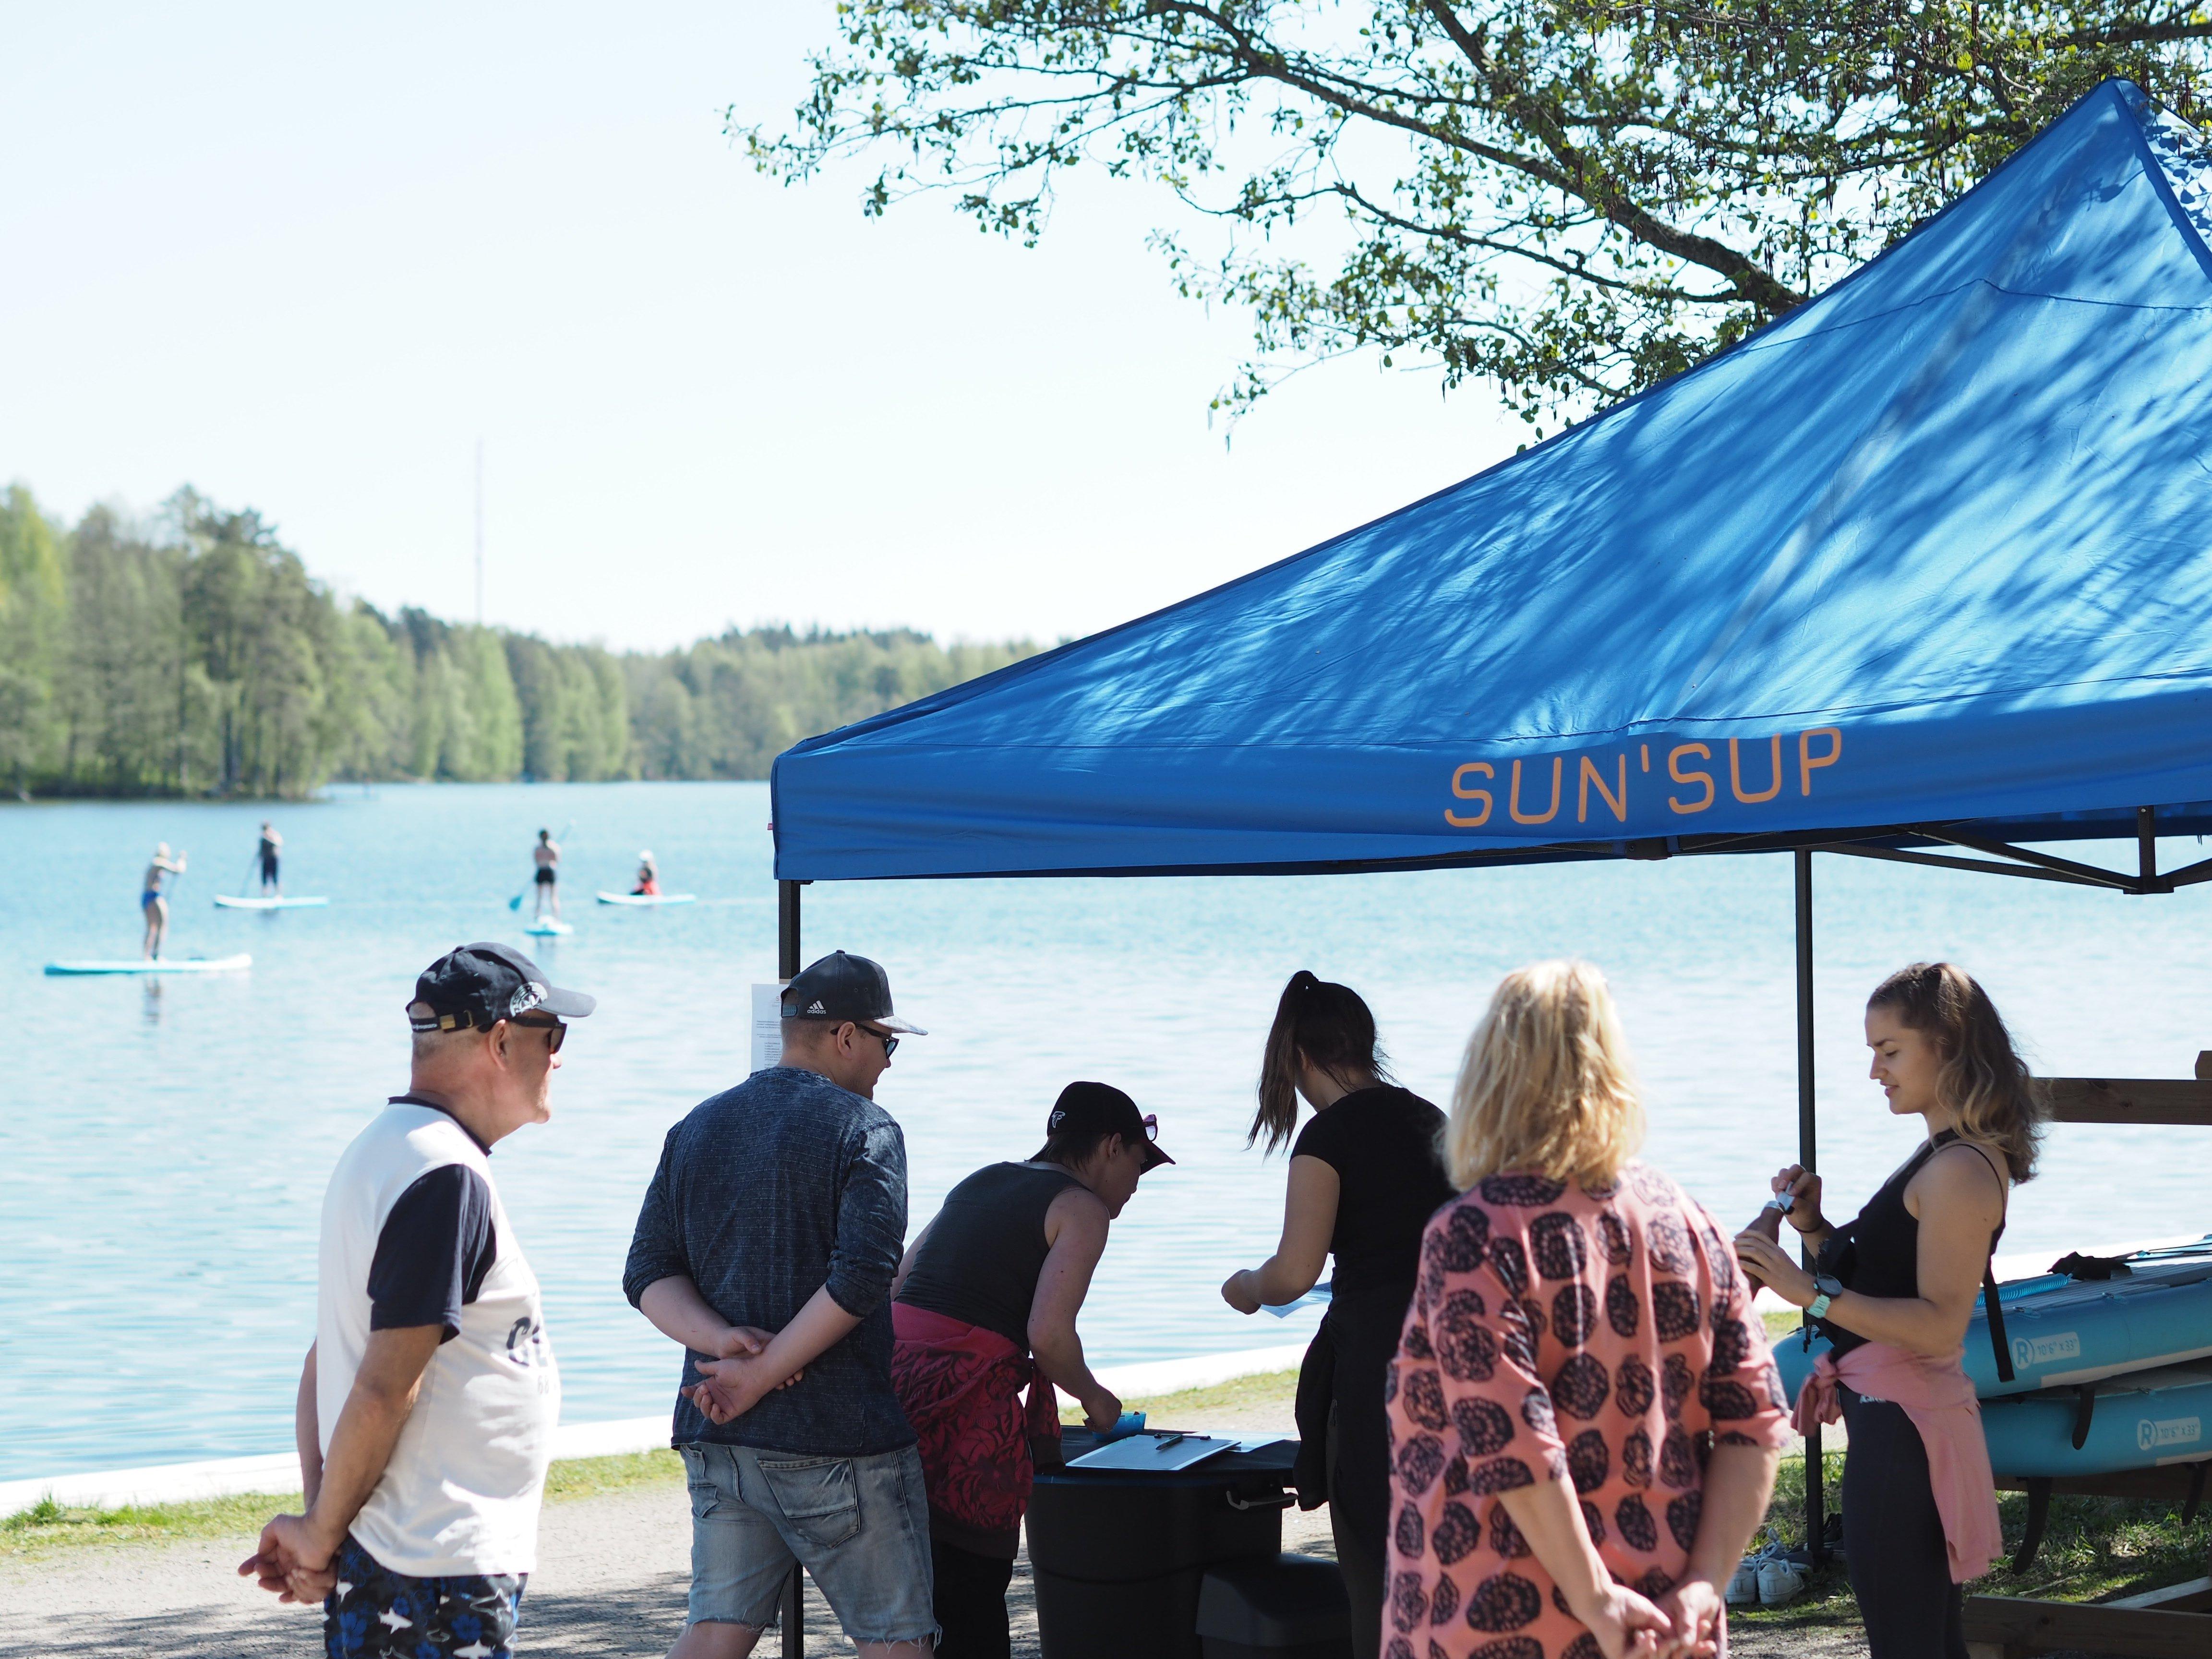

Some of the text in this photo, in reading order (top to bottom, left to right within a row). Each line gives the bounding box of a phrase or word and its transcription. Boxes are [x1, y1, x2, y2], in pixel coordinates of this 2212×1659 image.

[1444, 727, 1842, 827] SUN'SUP
[2016, 1341, 2028, 1364] R
[2141, 1423, 2152, 1446] R
